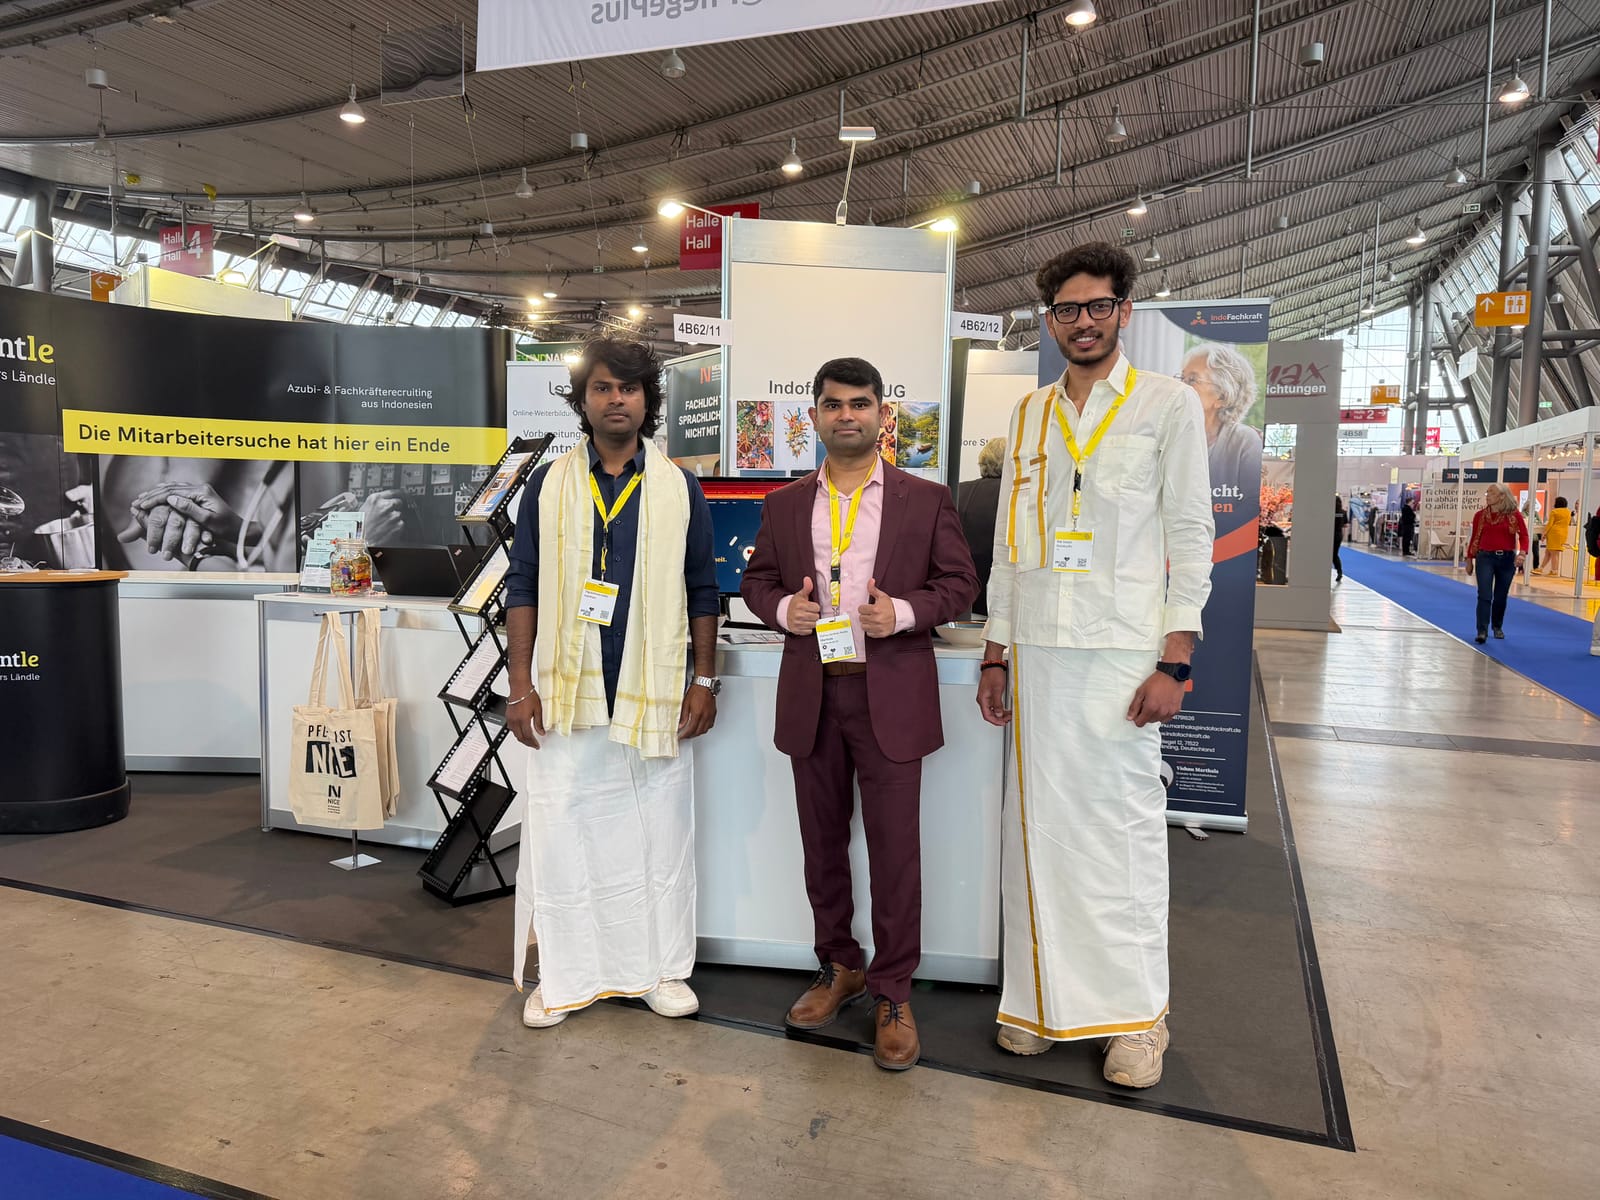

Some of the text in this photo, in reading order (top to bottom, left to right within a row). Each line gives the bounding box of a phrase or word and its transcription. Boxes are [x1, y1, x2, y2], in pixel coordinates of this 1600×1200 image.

[686, 213, 719, 229] Halle
[187, 230, 204, 259] 4
[686, 234, 711, 250] Hall
[1210, 313, 1263, 321] IndoFachkraft
[678, 322, 721, 337] 4B62/11
[960, 319, 999, 333] 4B62/12
[12, 370, 56, 386] Ländle
[287, 383, 433, 399] Azubi- & Fachkräfterecruiting
[361, 400, 433, 410] aus Indonesien
[685, 396, 719, 411] FACHLICH
[1367, 410, 1375, 419] 2
[79, 424, 450, 453] Die Mitarbeitersuche hat hier ein Ende
[685, 425, 719, 439] NICHT MIT
[1210, 484, 1244, 500] cht,
[10, 673, 40, 681] Ländle
[334, 729, 352, 743] IST
